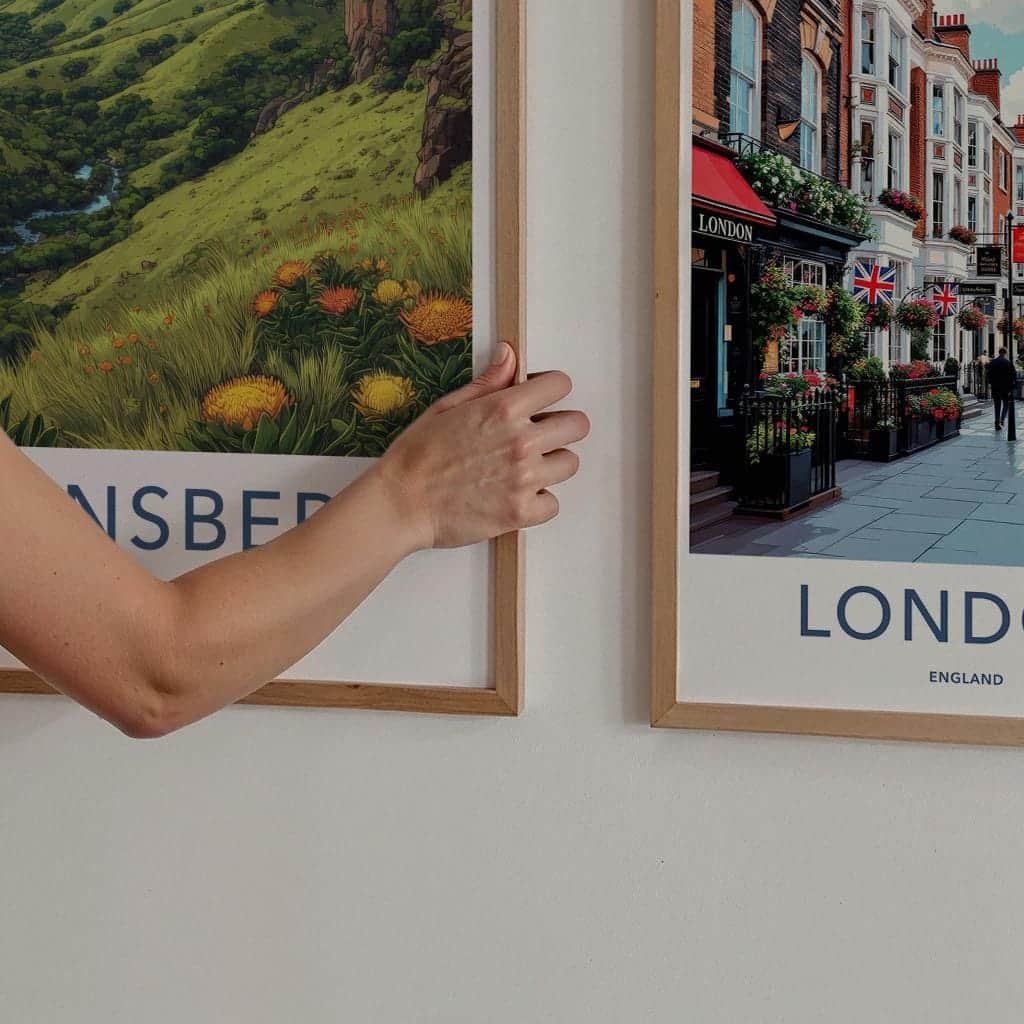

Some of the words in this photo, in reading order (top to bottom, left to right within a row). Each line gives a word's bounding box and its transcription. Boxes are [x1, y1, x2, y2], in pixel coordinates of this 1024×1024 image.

[698, 213, 753, 242] LONDON
[800, 584, 1024, 645] LOND
[929, 671, 1004, 686] ENGLAND
